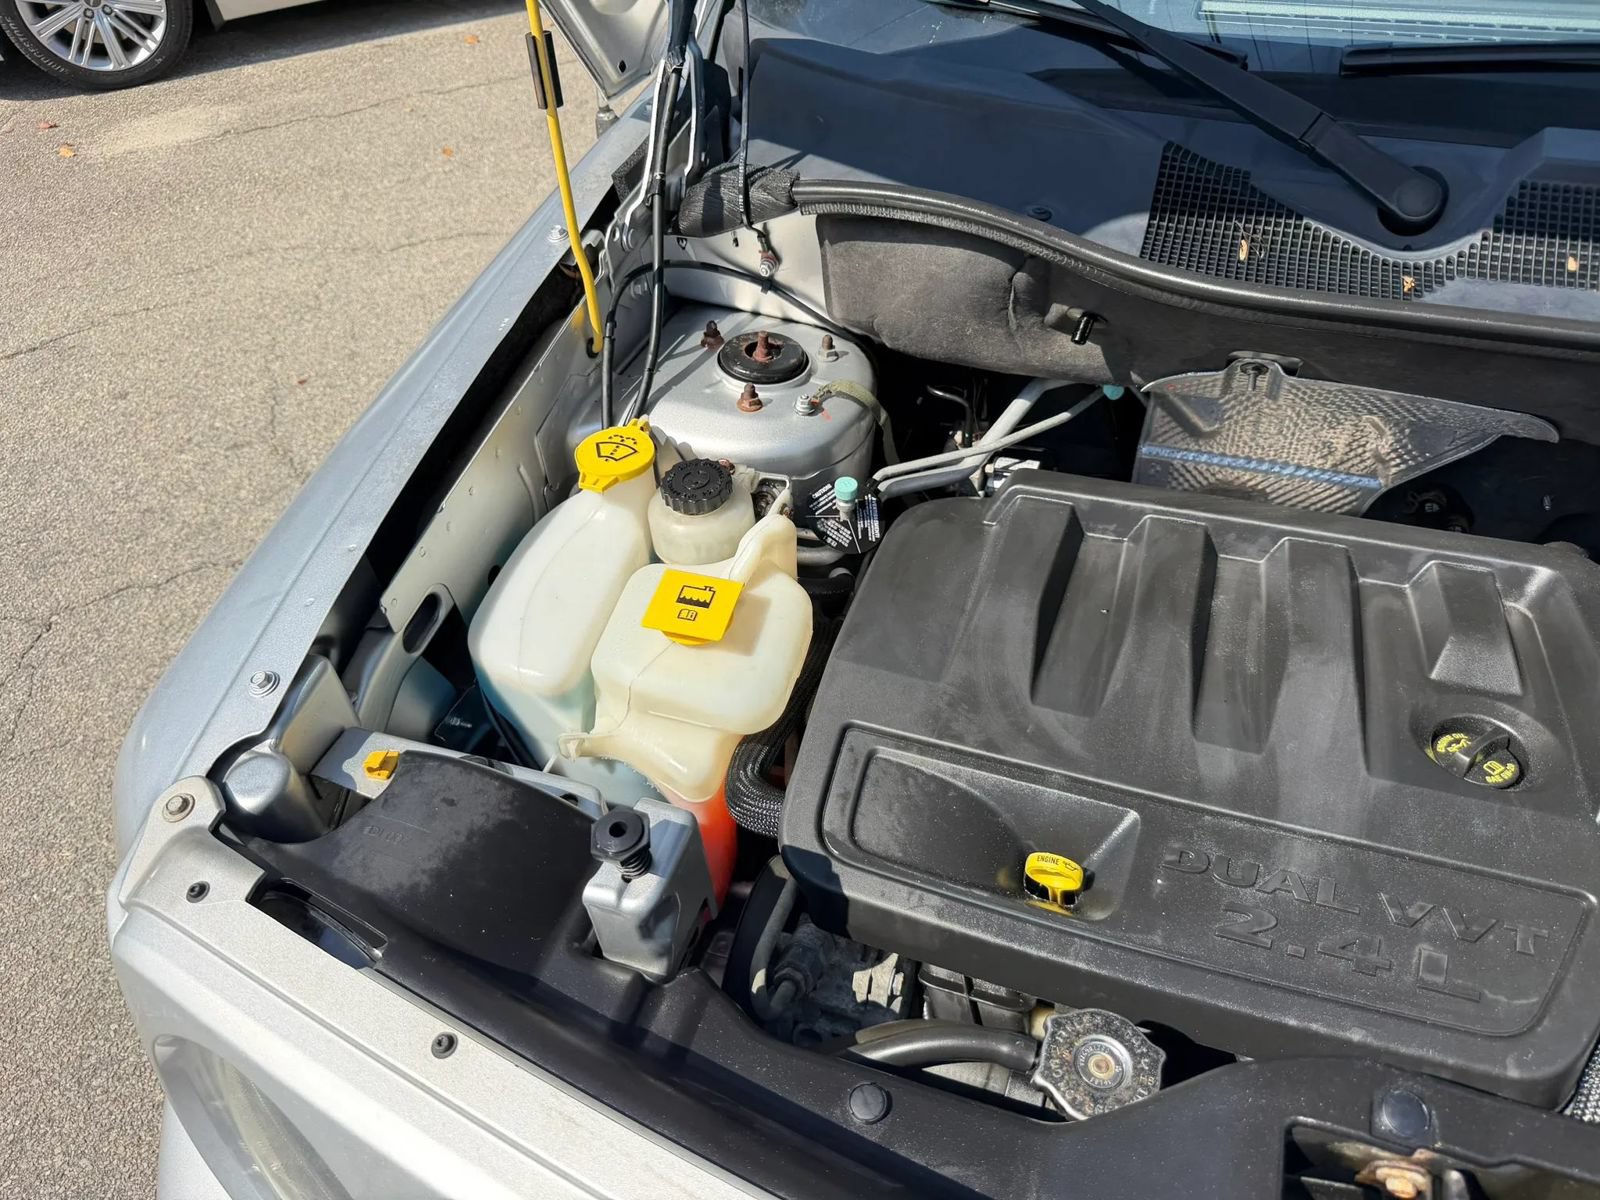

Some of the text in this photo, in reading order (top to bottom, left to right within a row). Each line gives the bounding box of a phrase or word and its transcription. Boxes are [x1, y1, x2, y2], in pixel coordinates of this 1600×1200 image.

[1036, 855, 1060, 866] ENGINE
[1158, 847, 1549, 955] DUAL VVT
